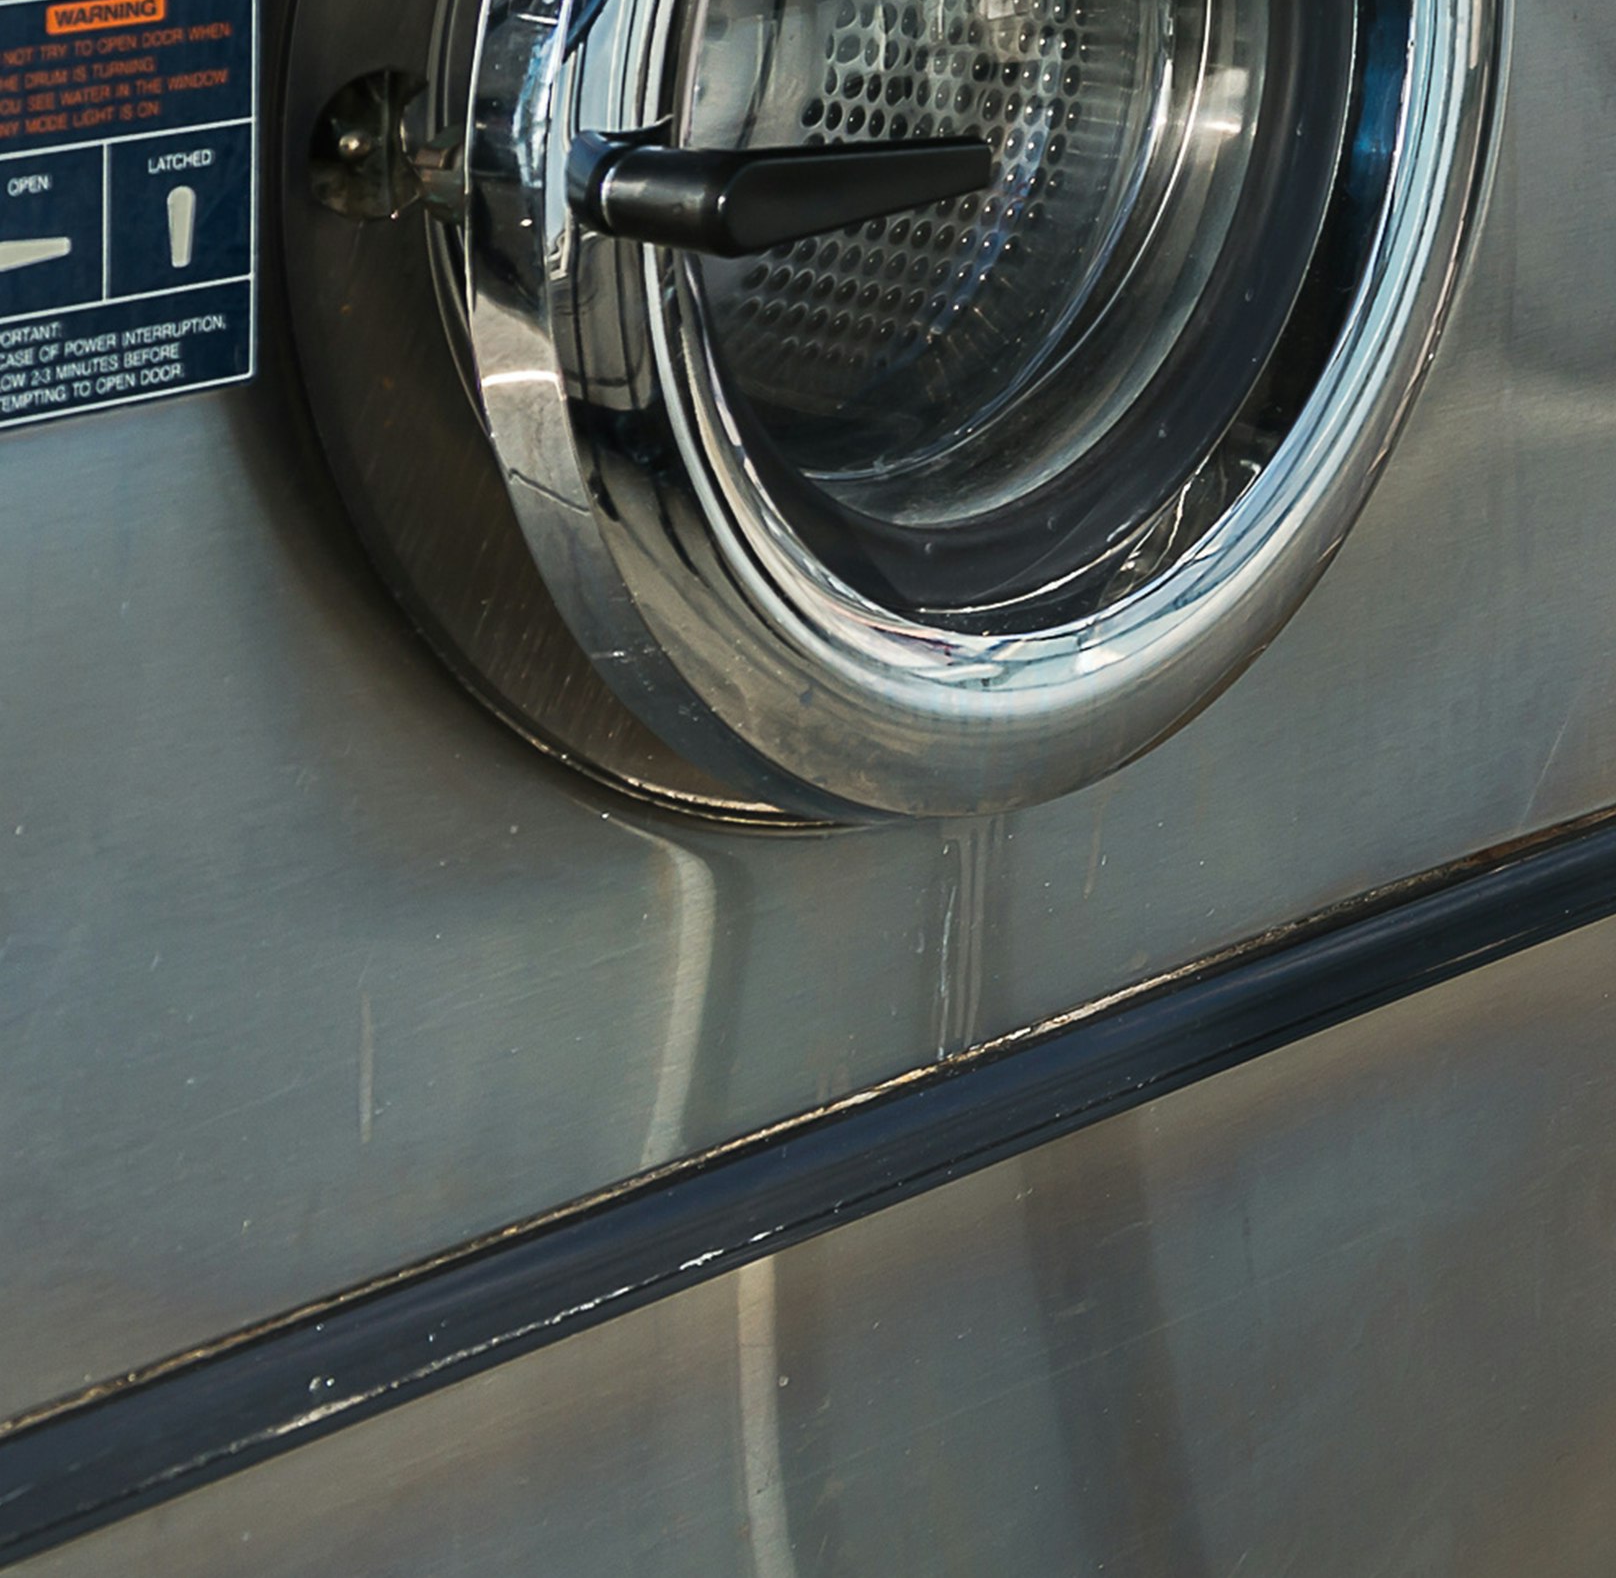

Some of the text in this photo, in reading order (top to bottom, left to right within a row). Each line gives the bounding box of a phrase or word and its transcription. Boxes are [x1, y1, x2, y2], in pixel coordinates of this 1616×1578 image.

[3, 22, 232, 66] NOT TRY TO OPEN DOOR WHEN
[25, 56, 156, 89] DRUM IS TURNING
[27, 69, 228, 112] SEE WATER IN THE WINDOW
[26, 100, 160, 134] MODE LIGHT IS ON
[148, 149, 213, 174] LATCHED
[8, 175, 51, 196] OPEN
[0, 322, 62, 348] ORTANT:
[39, 344, 59, 362] OF
[64, 333, 116, 357] POWER
[31, 368, 51, 386] 2-3
[56, 355, 118, 380] MINUTES
[124, 342, 180, 368] BEFORE
[73, 381, 91, 398] TO
[96, 373, 135, 395] OPEN
